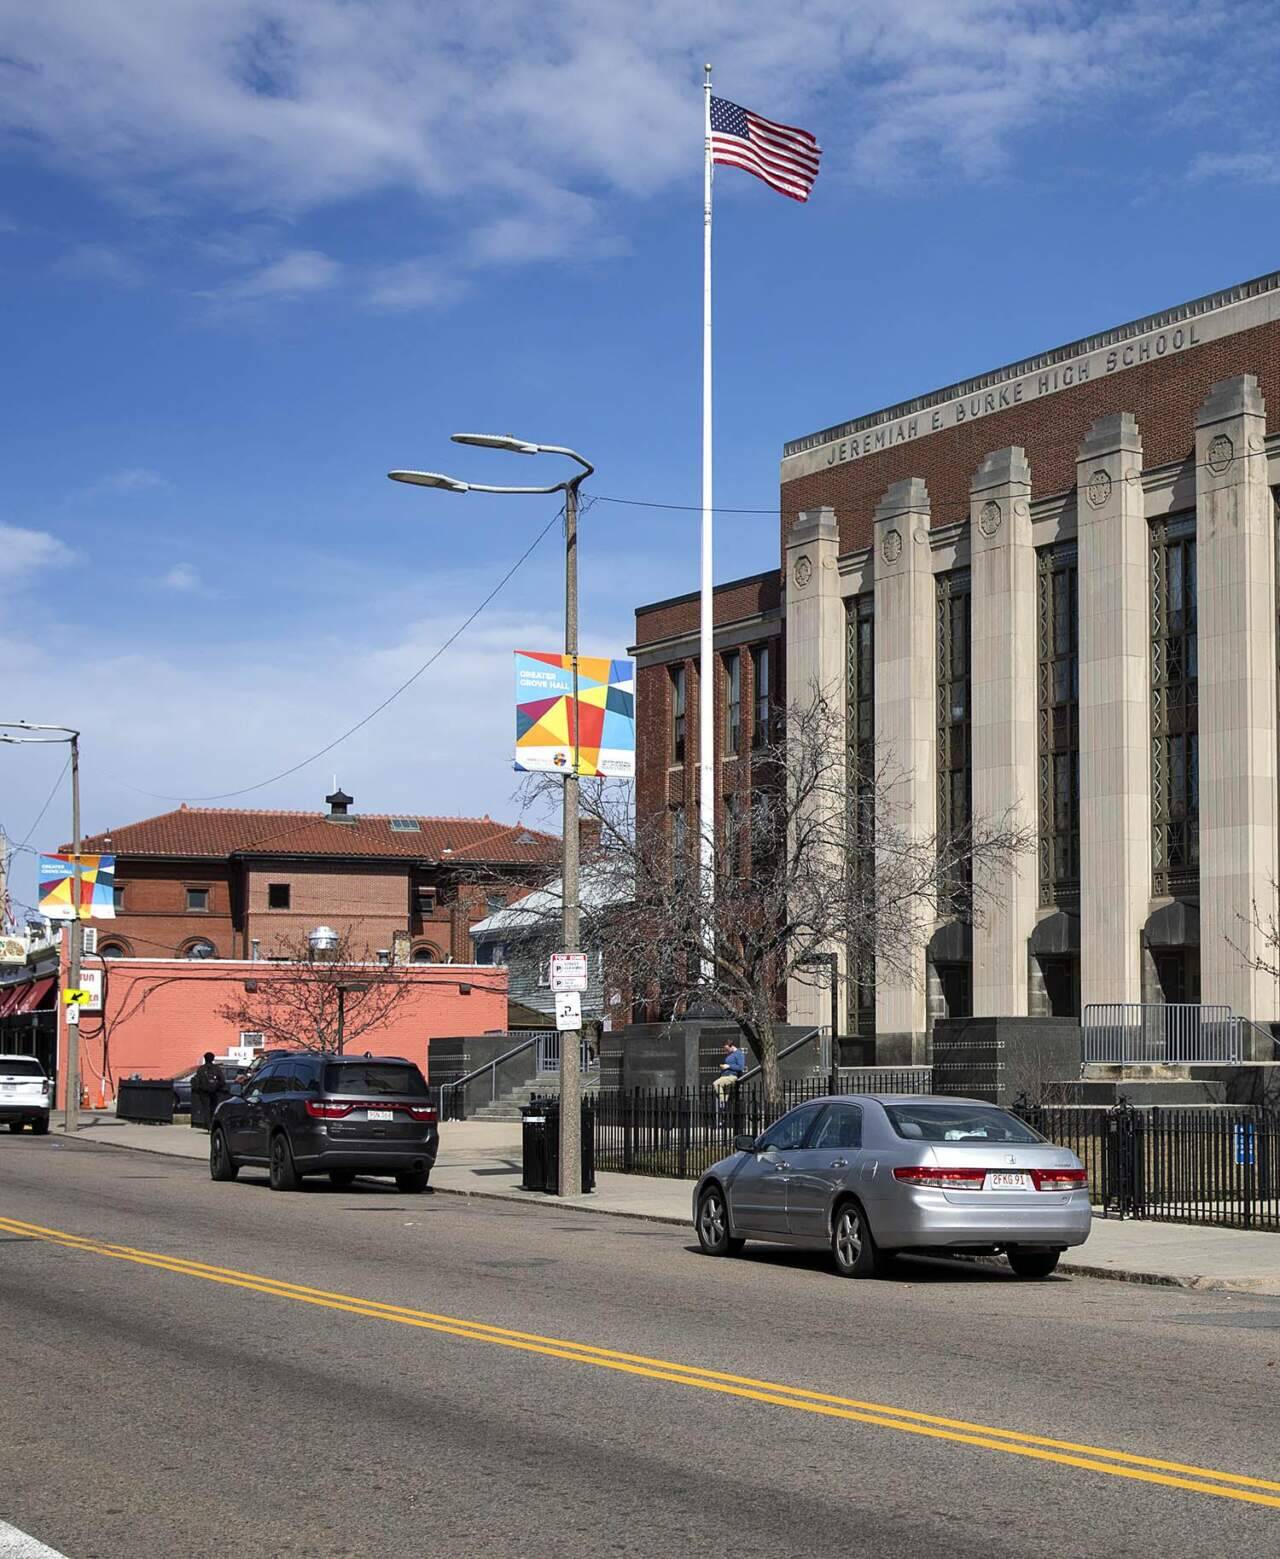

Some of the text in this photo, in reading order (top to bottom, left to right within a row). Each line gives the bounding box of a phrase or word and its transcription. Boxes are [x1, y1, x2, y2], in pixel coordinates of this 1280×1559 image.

[826, 325, 1200, 466] JEREMIAH E. BURKE HIGH SCHOOL
[520, 671, 556, 680] GREATER
[520, 680, 570, 690] GROVE HALL
